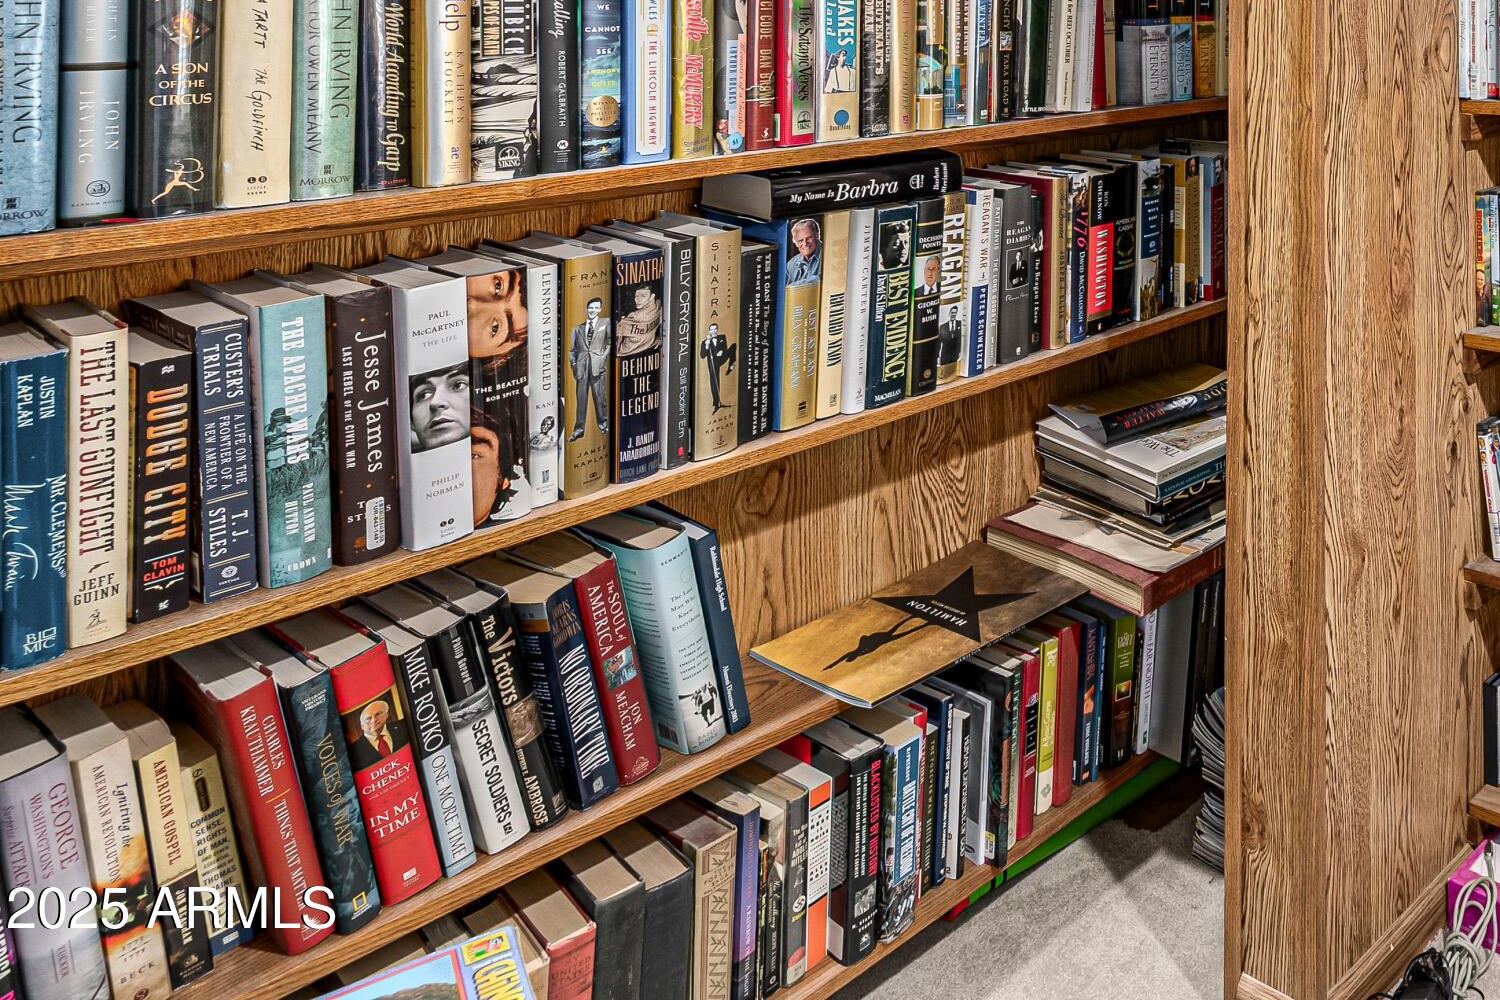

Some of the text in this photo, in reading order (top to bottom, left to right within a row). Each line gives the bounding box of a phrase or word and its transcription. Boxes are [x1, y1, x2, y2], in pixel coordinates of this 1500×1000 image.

[154, 63, 208, 75] A SON
[159, 79, 205, 88] OF THE
[13, 52, 42, 144] IRVING
[149, 93, 212, 107] CIRCUS
[558, 51, 566, 127] ROBERT GALBRAITH
[300, 174, 352, 187] MORROW
[789, 192, 803, 205] My
[804, 190, 825, 201] Name
[834, 179, 898, 202] Barbra
[940, 212, 964, 301] REAGAN
[1093, 228, 1109, 308] WASHINGTON
[427, 309, 451, 321] PAUL
[678, 248, 691, 362] BILLY CRYSTAL
[542, 272, 551, 391] LENNON REVEALED
[884, 271, 909, 383] BEST EVIDENCE
[202, 343, 221, 397] TRIALS
[224, 332, 244, 399] CUSTER'S
[354, 330, 389, 474] Jesse James
[475, 376, 528, 395] THE BEATLES
[144, 383, 188, 545] DODGE CITY
[430, 473, 460, 487] PHILIP
[425, 481, 465, 500] NORMAN
[208, 507, 228, 558] STILES
[143, 563, 185, 582] CLAVIN
[151, 557, 178, 570] TOM
[73, 584, 120, 607] GUINN
[79, 572, 116, 593] JEFF
[906, 599, 968, 628] HAMILTON
[404, 647, 444, 753] MIKE ROYKO
[240, 705, 275, 798] KRAUTHAMMER
[263, 714, 286, 771] CHARLES
[361, 766, 412, 796] CHENEY
[369, 759, 401, 783] DICK
[472, 719, 513, 824] SECRET SOLDIERS
[369, 793, 419, 830] IN MY
[374, 806, 421, 841] TIME
